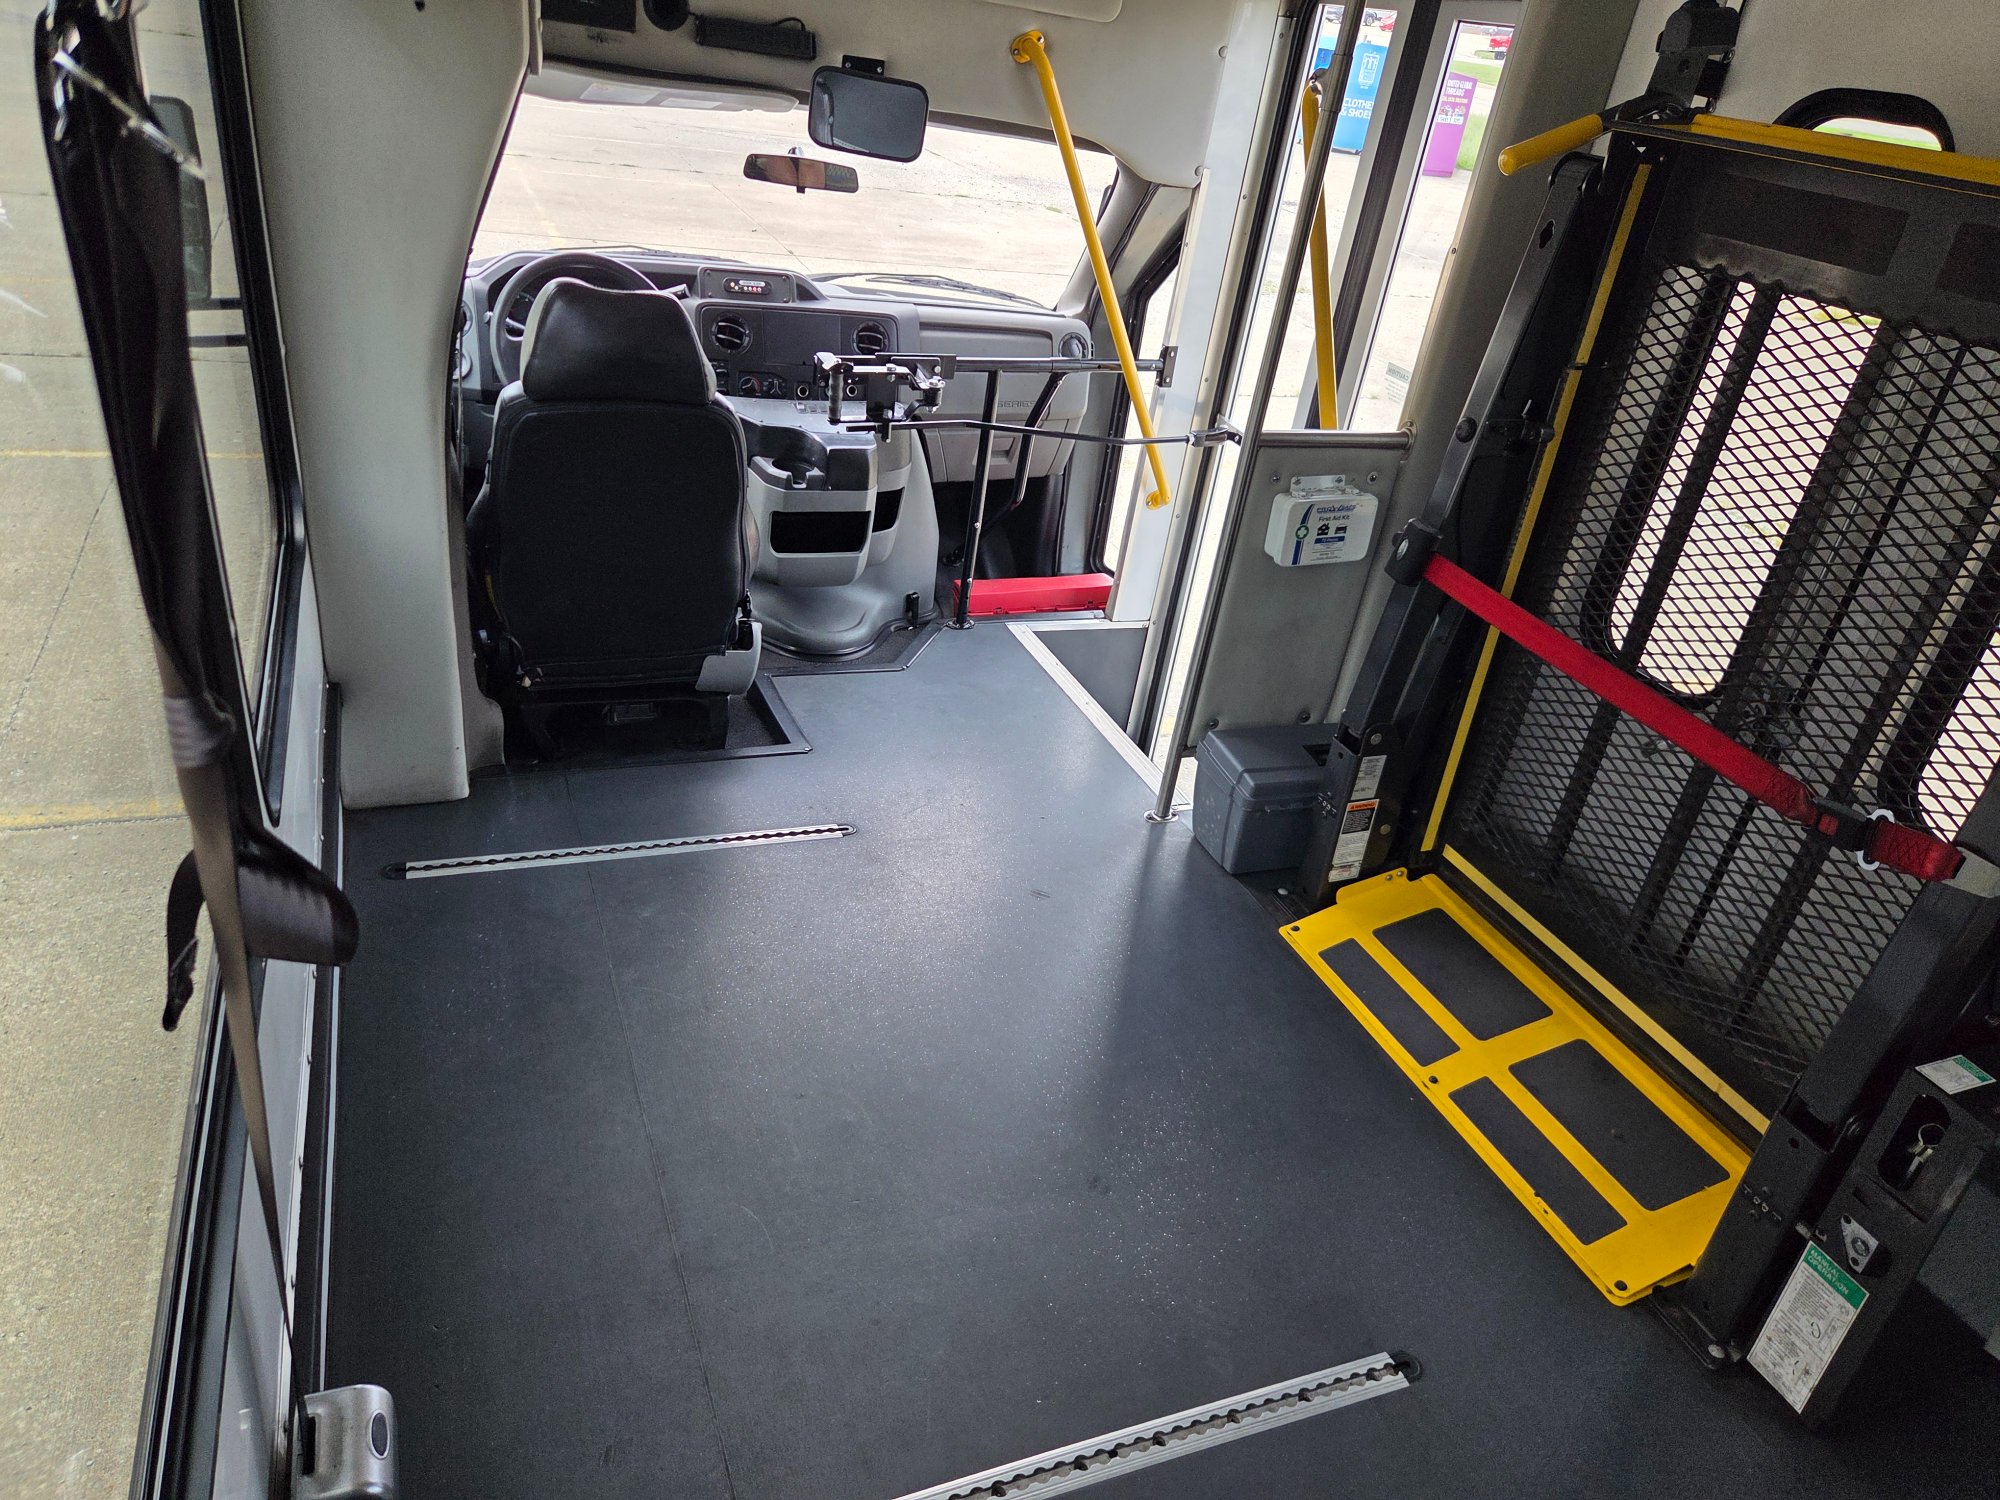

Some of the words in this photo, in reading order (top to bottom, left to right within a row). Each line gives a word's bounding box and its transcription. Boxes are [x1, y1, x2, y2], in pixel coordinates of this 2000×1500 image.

[1340, 106, 1348, 116] &
[1347, 108, 1372, 119] SHOE
[1343, 97, 1374, 110] CLOTHE
[1810, 1249, 1840, 1278] MANUAL
[1807, 1255, 1849, 1295] OPERATION
